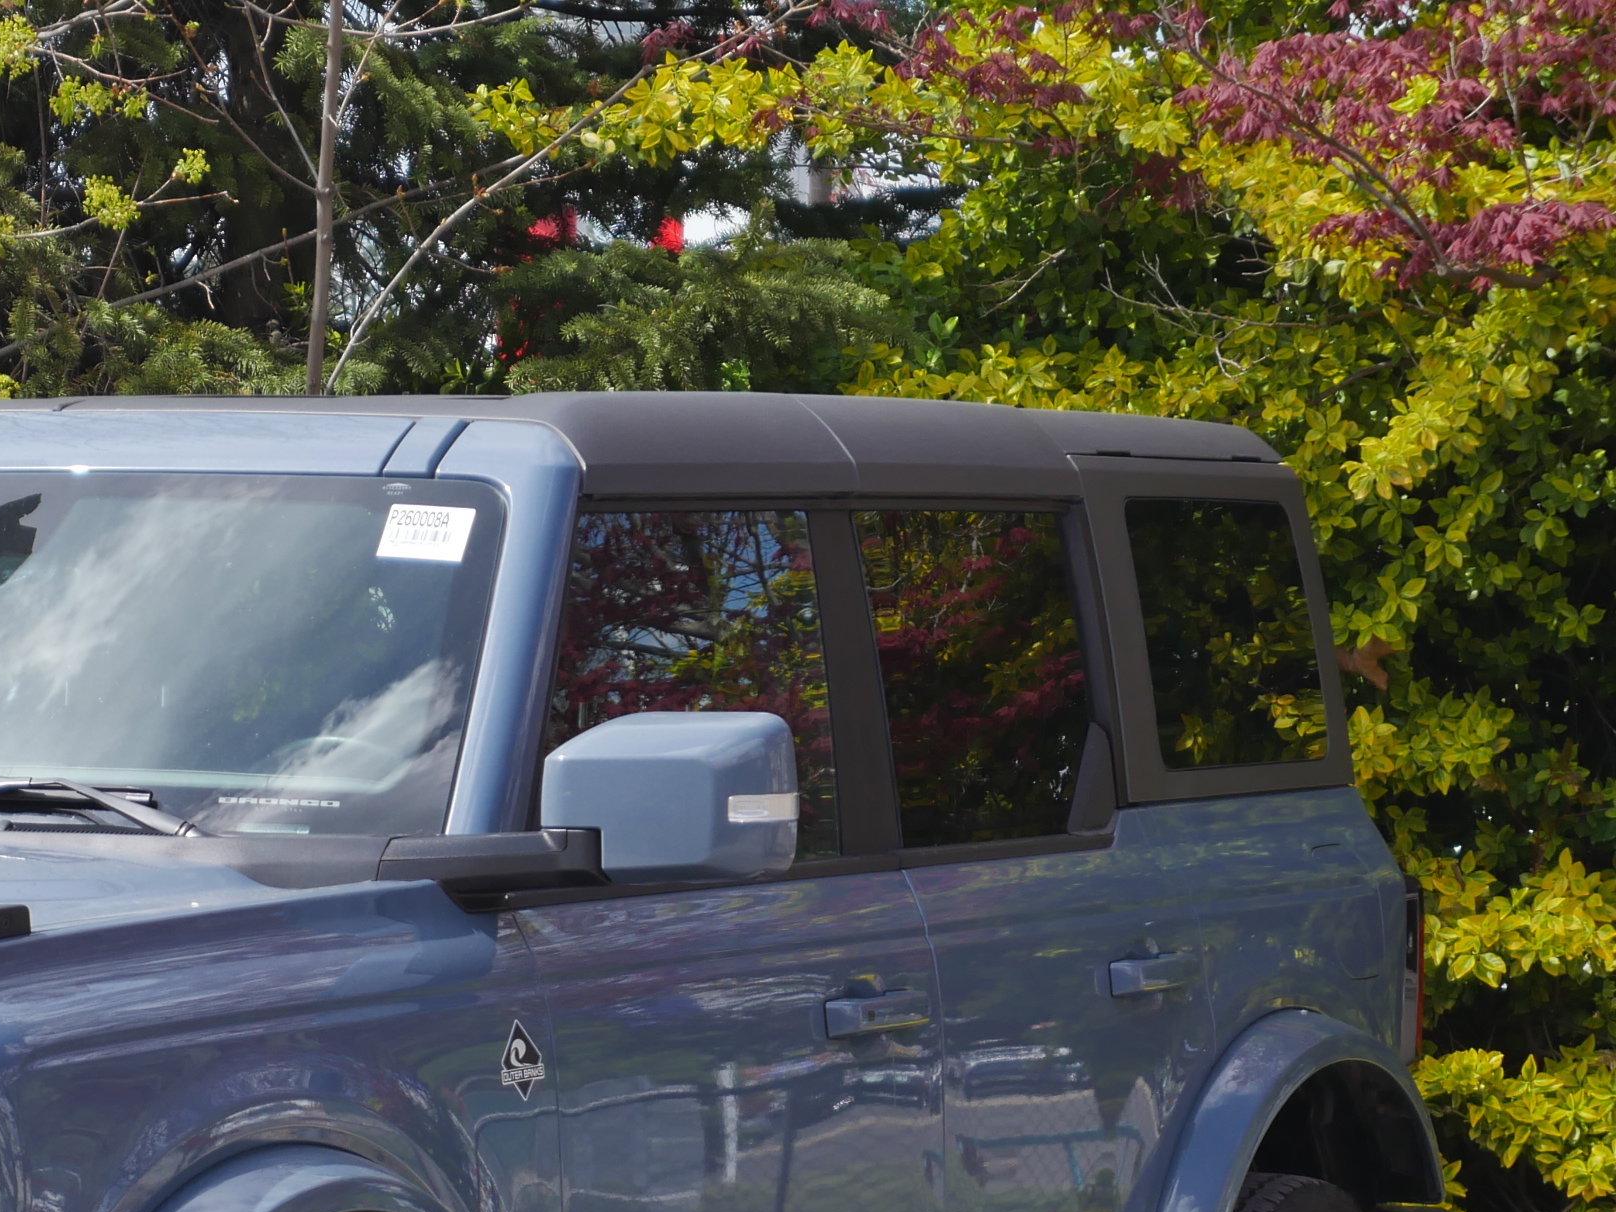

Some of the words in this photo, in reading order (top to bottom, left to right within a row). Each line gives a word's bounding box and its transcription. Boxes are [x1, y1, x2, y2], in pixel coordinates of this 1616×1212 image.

[389, 509, 450, 528] P260008A
[218, 796, 341, 808] BRONCO
[503, 1070, 523, 1082] OUTER
[523, 1067, 544, 1078] BANKS
